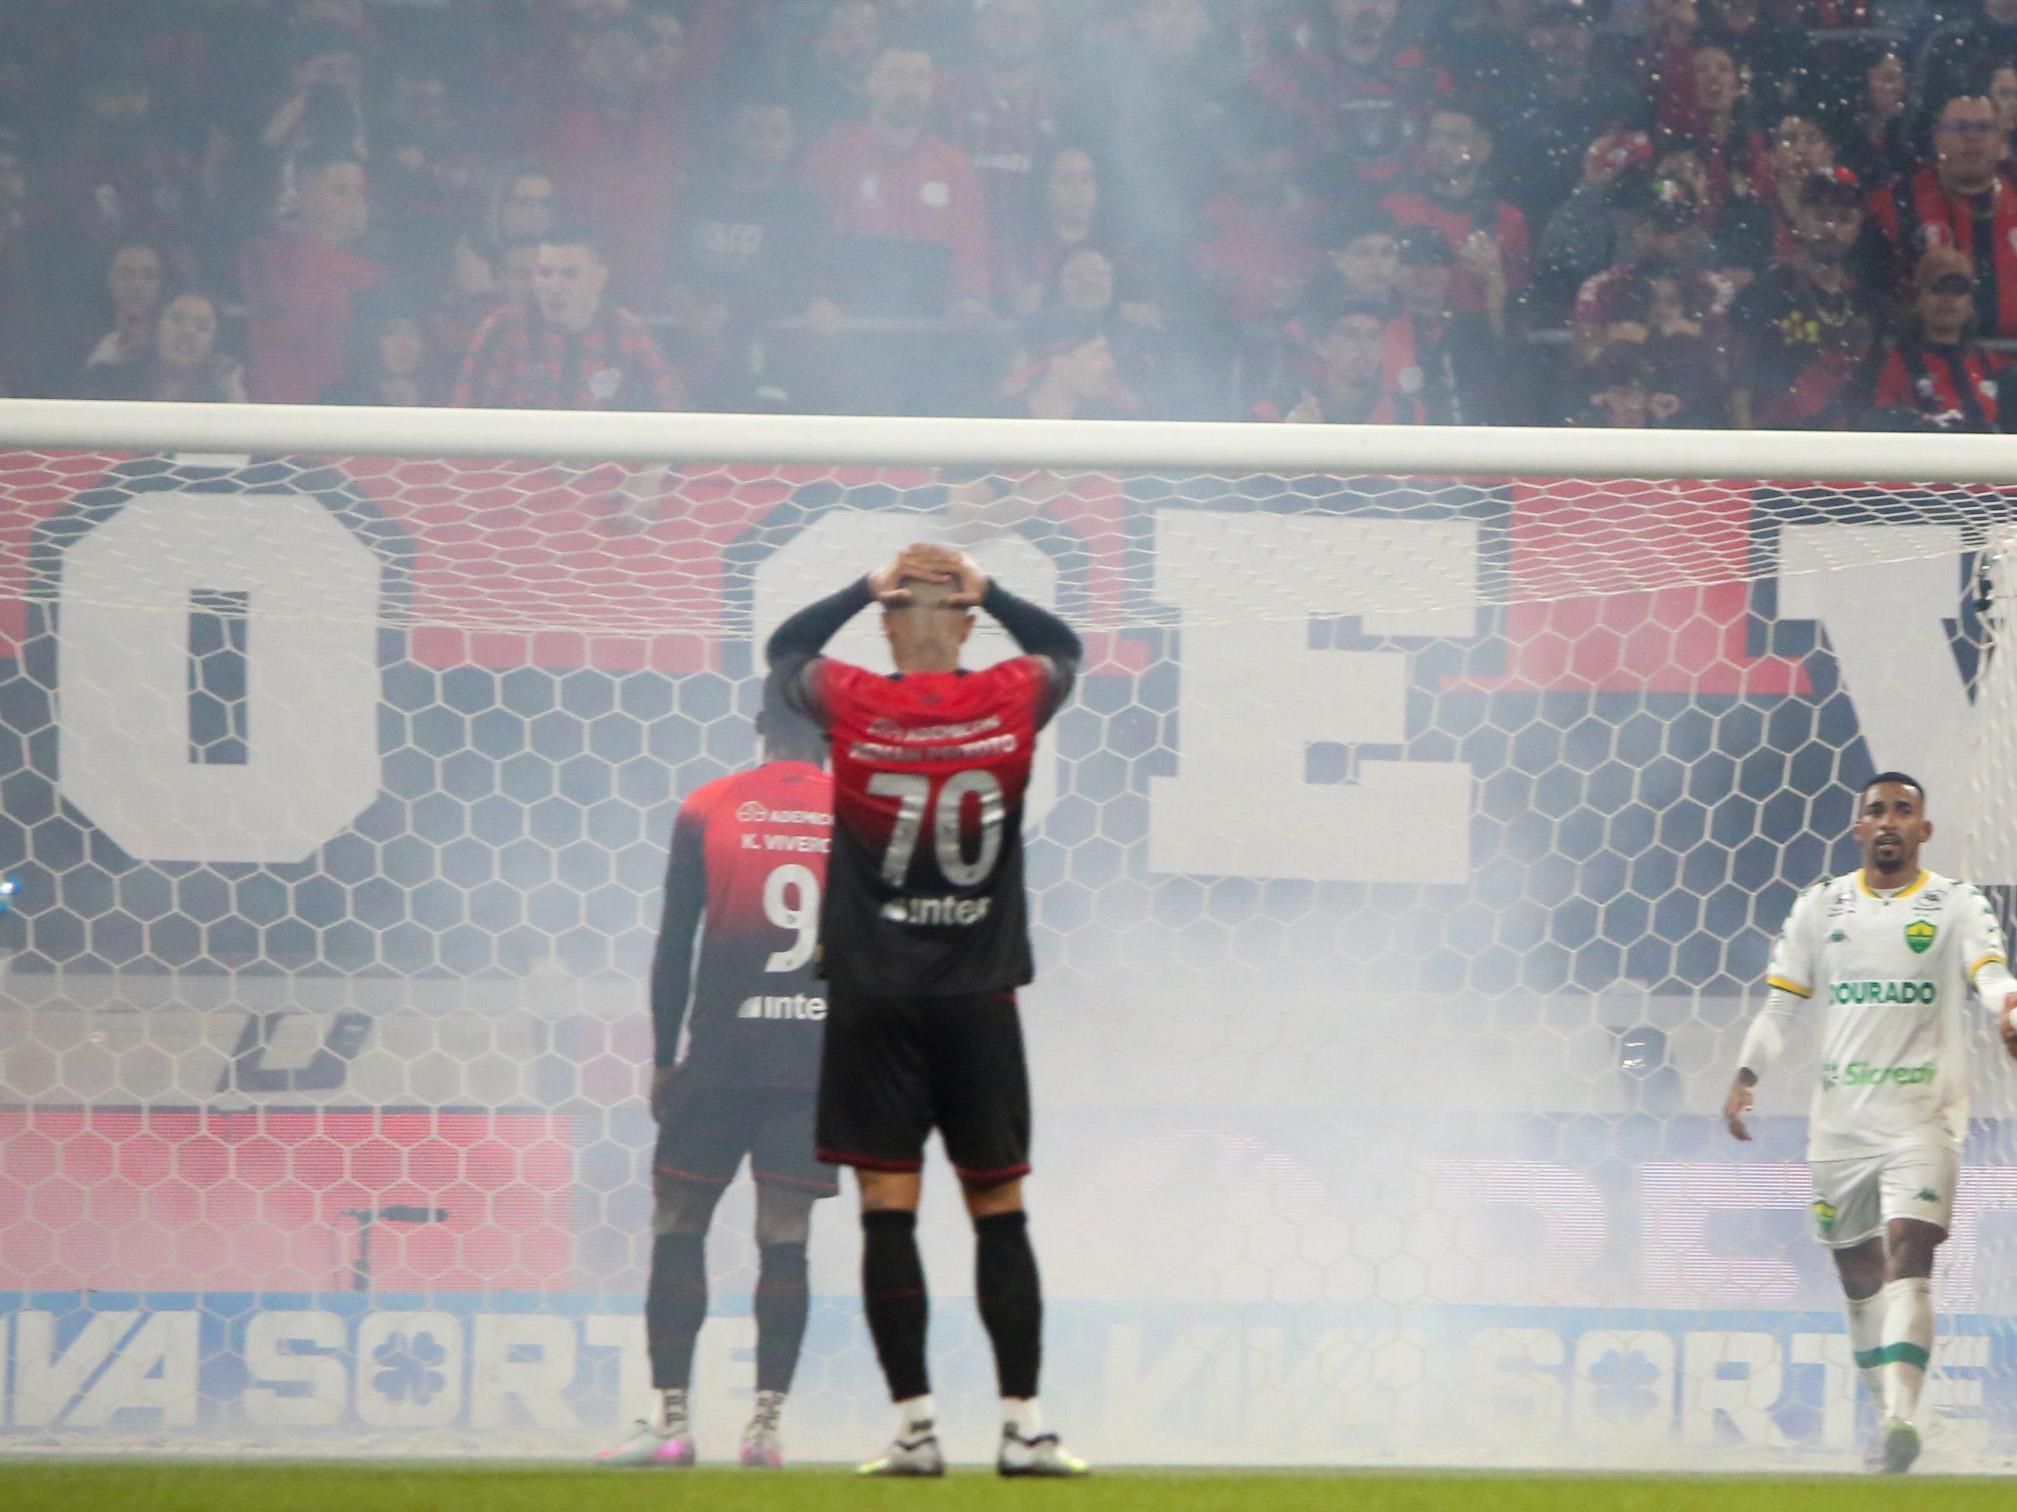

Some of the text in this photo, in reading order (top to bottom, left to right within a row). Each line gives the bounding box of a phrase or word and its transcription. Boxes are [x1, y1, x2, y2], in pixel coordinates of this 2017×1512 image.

[762, 834, 832, 854] VIVERO
[867, 769, 1006, 888] 70
[763, 863, 821, 973] 9
[765, 993, 828, 1021] inte
[1829, 981, 1937, 1005] OURADO
[0, 1310, 200, 1428] VA
